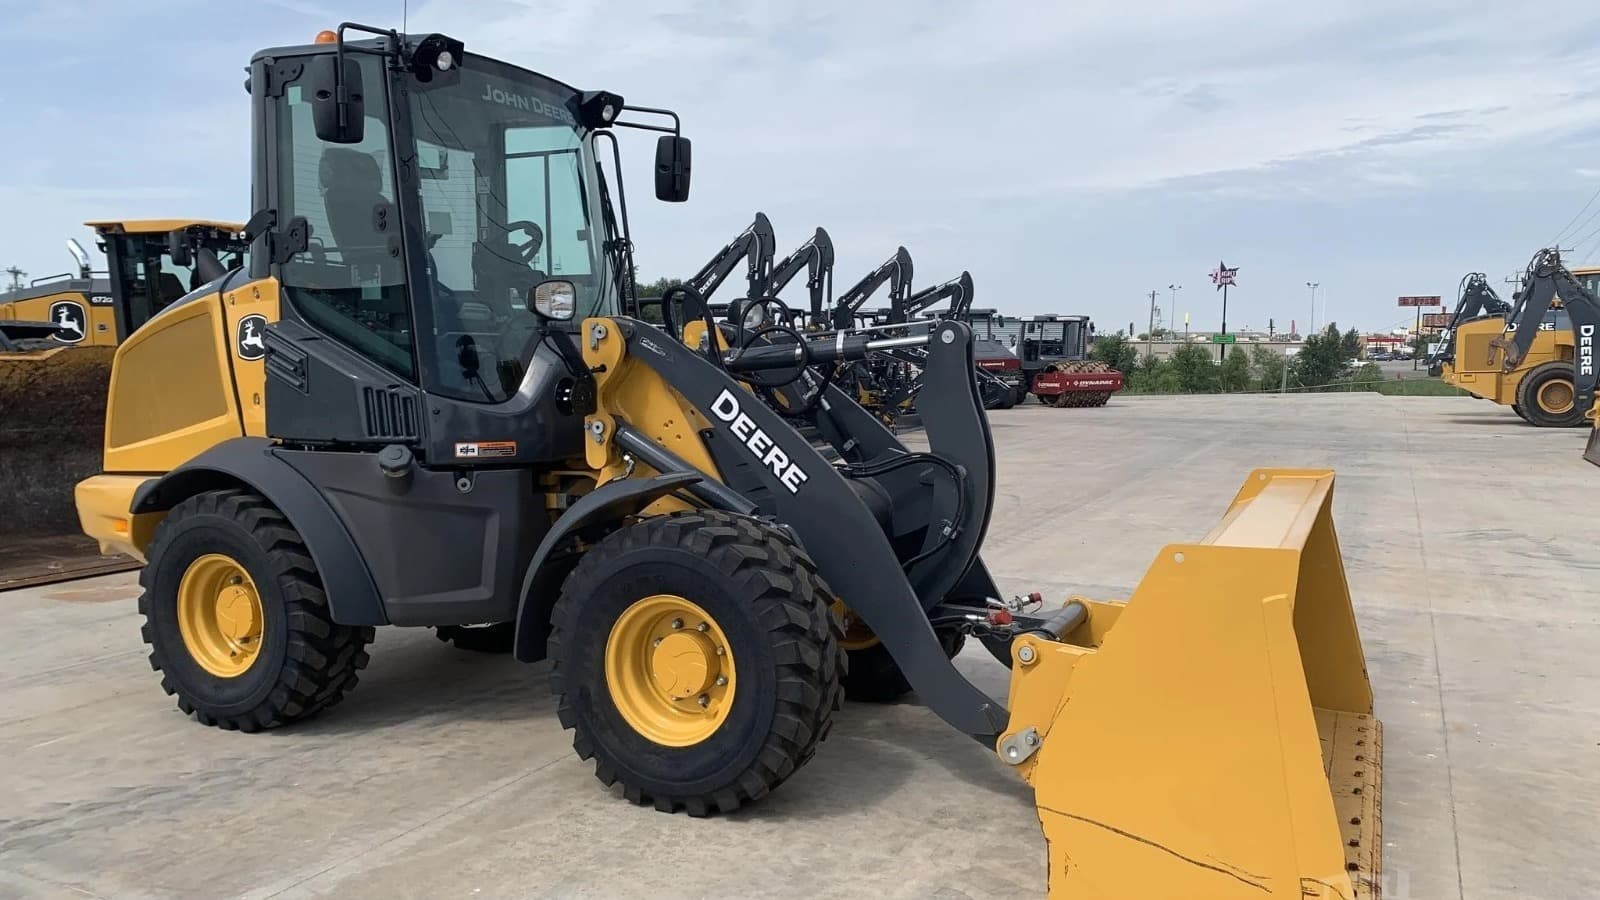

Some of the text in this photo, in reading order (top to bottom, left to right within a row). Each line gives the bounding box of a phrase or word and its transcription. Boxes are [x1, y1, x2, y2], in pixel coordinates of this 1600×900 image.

[482, 83, 530, 110] JOHN
[698, 273, 718, 295] DEERE
[1580, 324, 1595, 376] DEERE
[710, 388, 808, 494] DEERE
